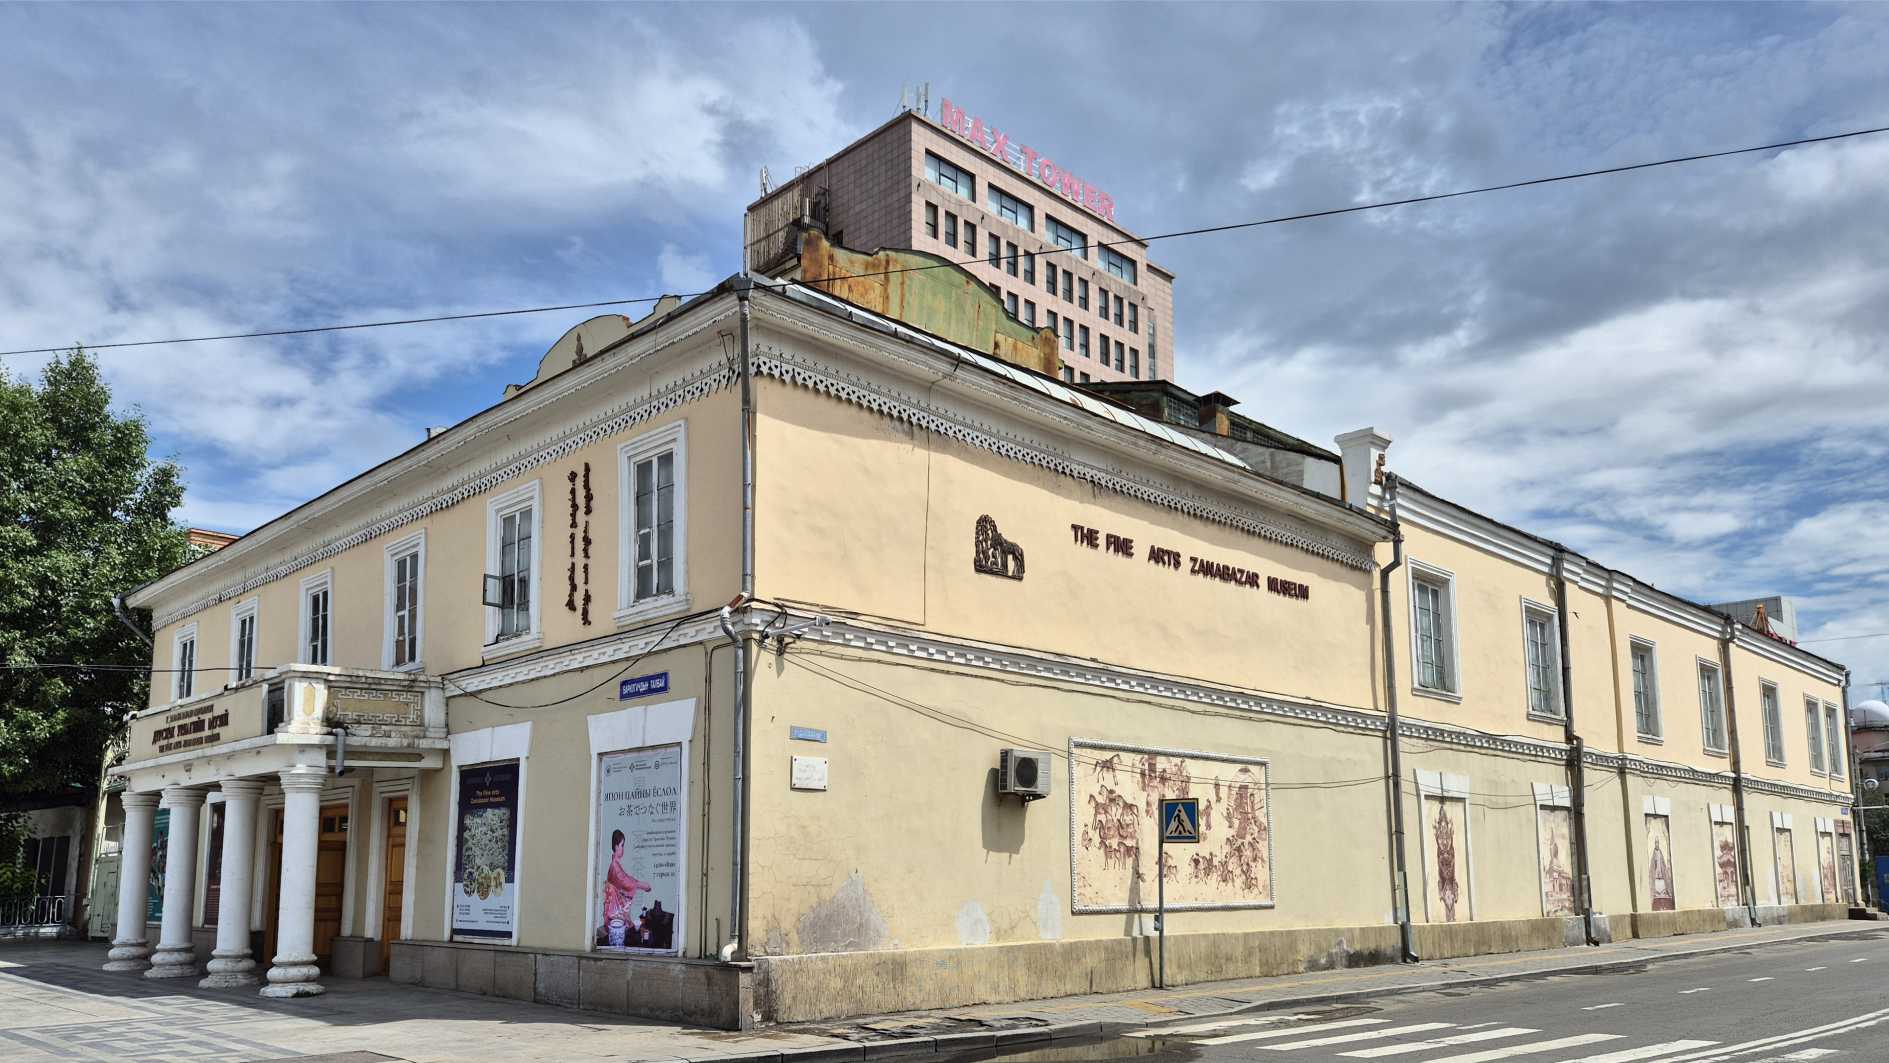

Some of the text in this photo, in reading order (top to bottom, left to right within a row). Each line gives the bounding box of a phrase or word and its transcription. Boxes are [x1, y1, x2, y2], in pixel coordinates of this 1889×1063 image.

[941, 98, 1116, 223] MAX TOWER
[1071, 523, 1310, 601] THE FINE ARTS ZANABAZAR MUSEUM
